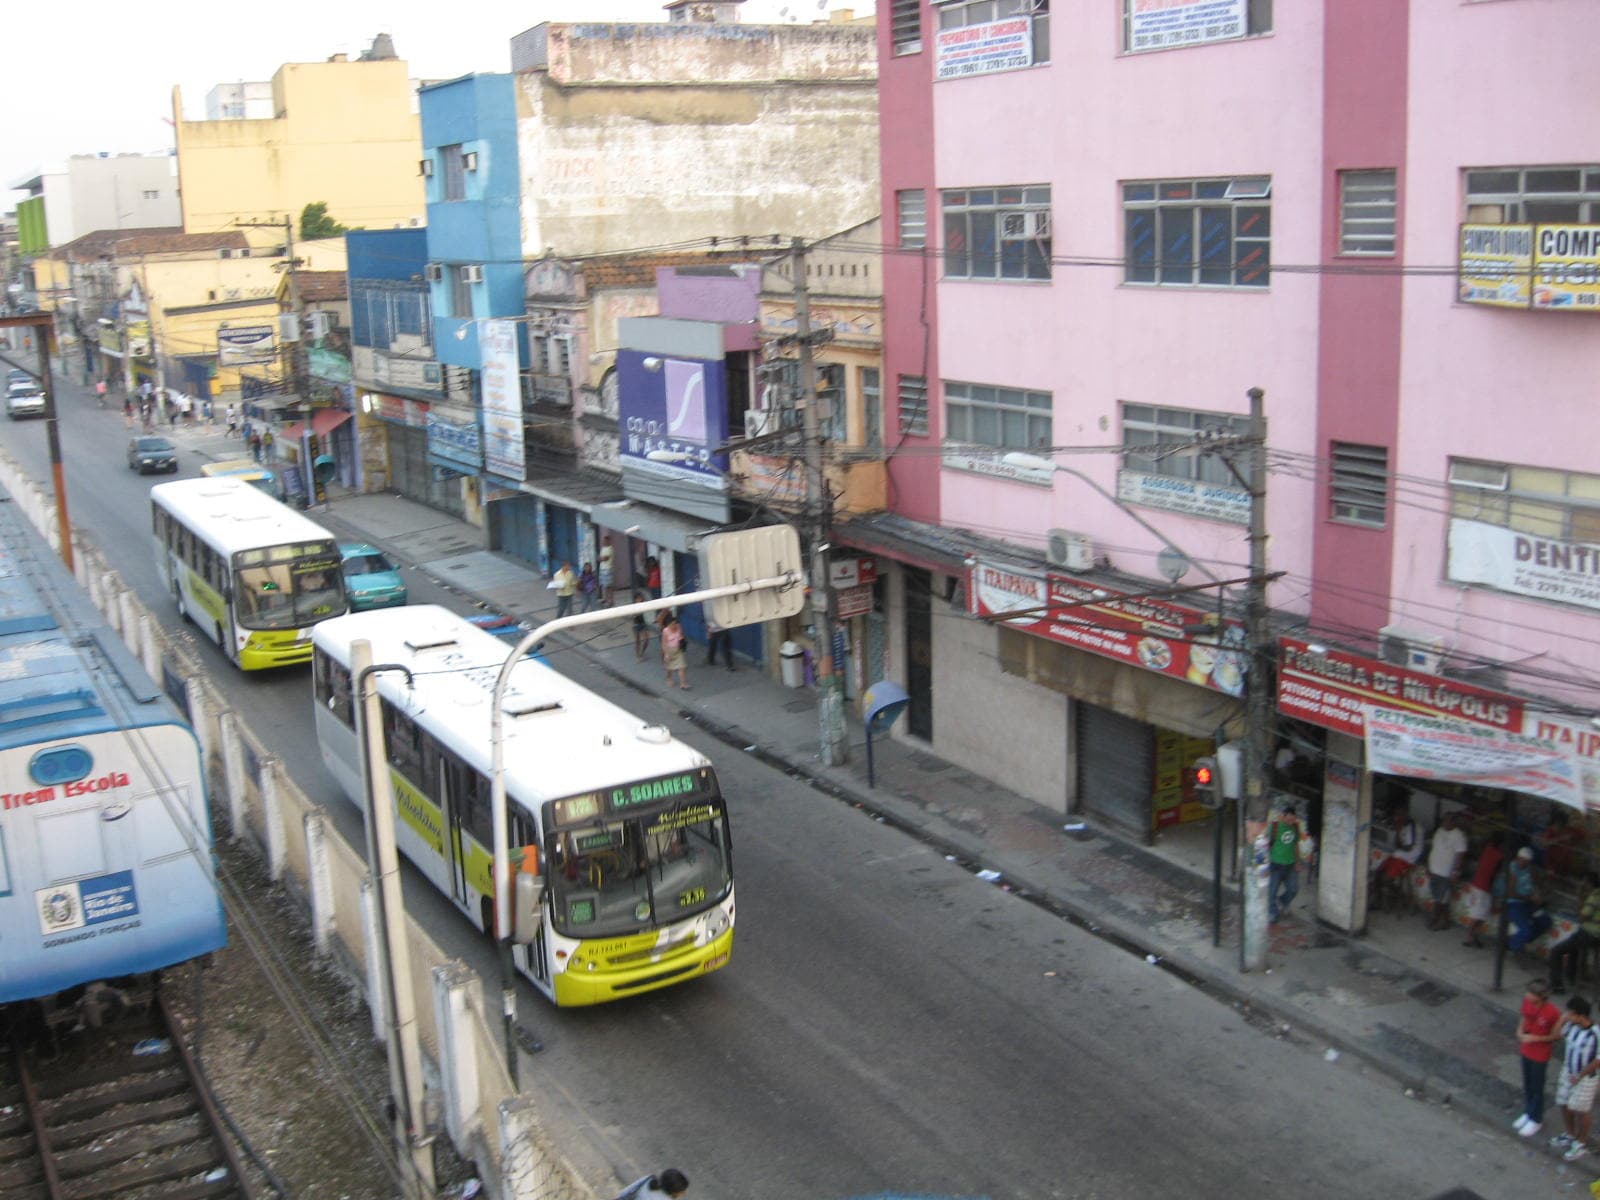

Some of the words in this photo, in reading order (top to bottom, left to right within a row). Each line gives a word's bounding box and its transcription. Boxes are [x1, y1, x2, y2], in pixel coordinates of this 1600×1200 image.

[984, 568, 1039, 600] ITAIPAVA
[1372, 670, 1400, 696] DE
[1402, 675, 1511, 727] NILÓPOLIS
[0, 787, 56, 810] Trem
[63, 772, 131, 798] Escola
[612, 788, 629, 808] C.
[630, 774, 694, 804] SOARES
[86, 901, 137, 920] Janeiro
[43, 930, 97, 949] SOMANDO
